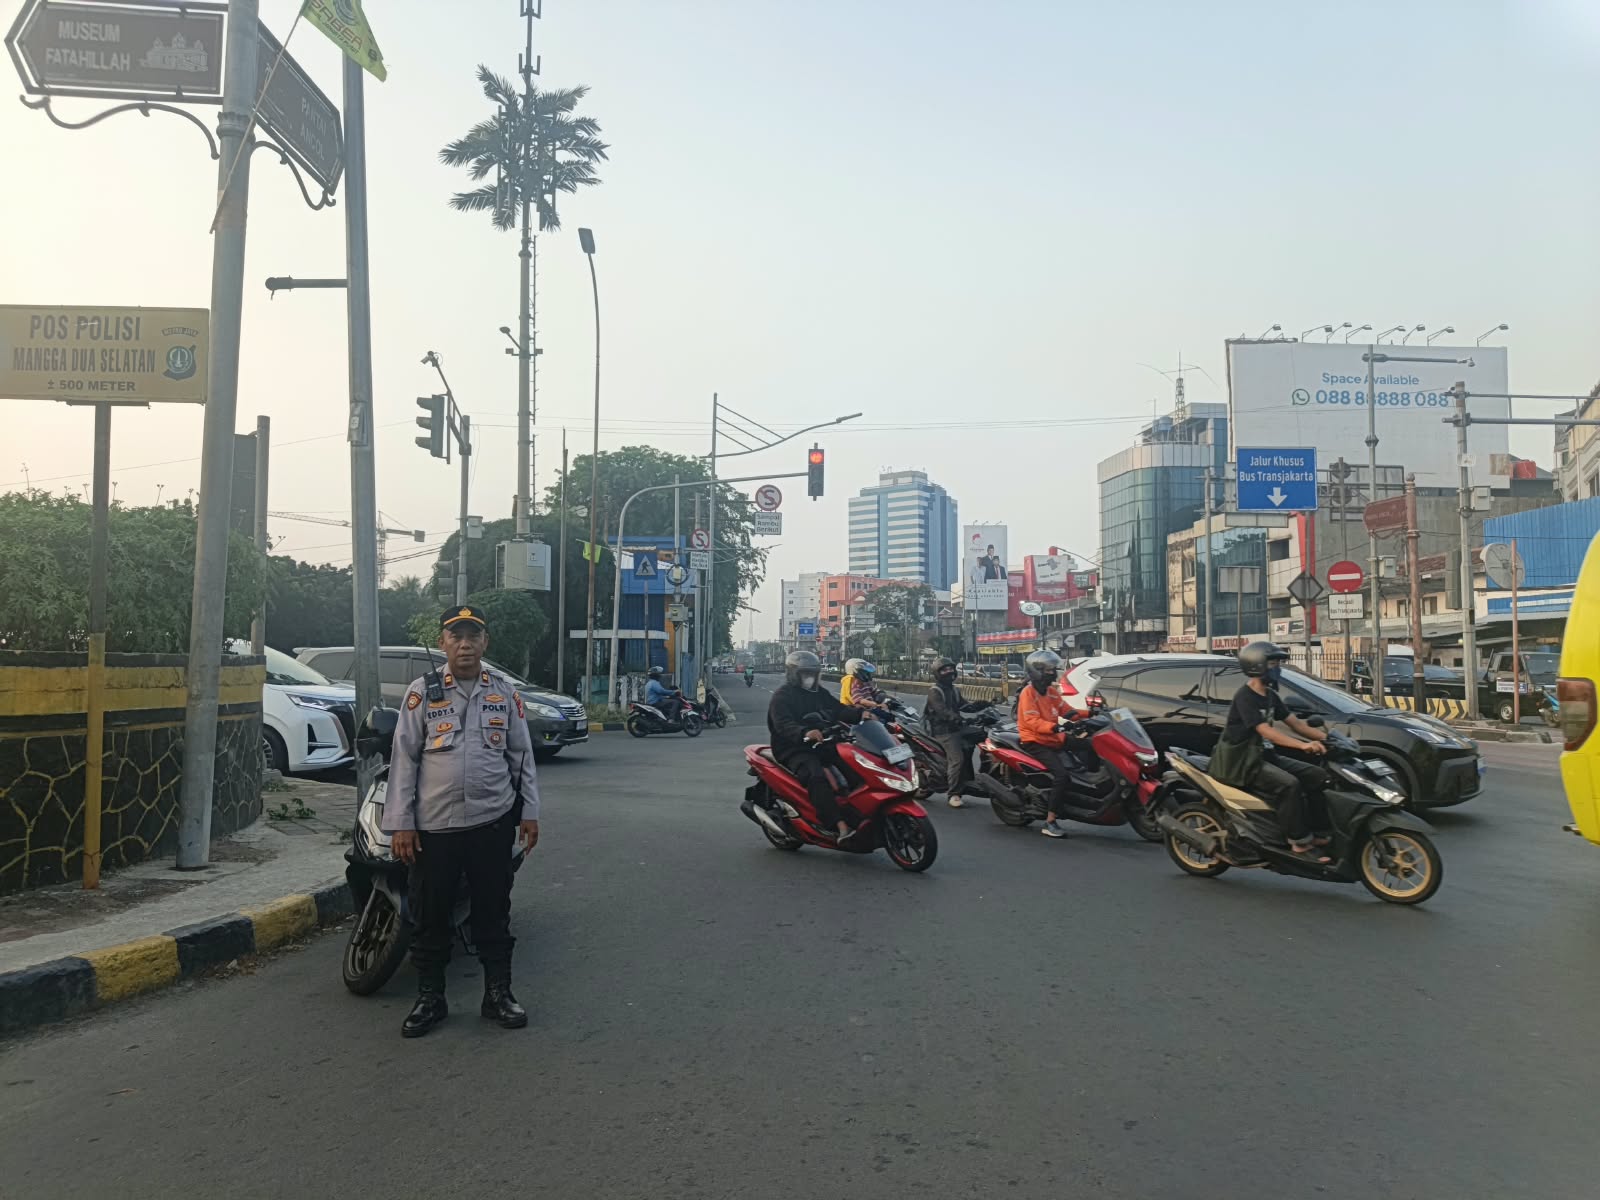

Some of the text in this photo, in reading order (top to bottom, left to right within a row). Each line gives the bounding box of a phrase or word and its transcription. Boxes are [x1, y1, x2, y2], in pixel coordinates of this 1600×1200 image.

[58, 20, 120, 42] MUSEUM
[46, 47, 131, 72] FATAHILLAH
[301, 97, 327, 138] PANTAI
[30, 314, 141, 341] POS POLISI
[12, 347, 156, 374] MANGGA DUA SELATAN
[60, 380, 84, 391] 500
[88, 380, 136, 392] METER
[1322, 372, 1362, 386] Space
[1315, 389, 1351, 405] 088
[1414, 392, 1449, 407] 088
[1250, 455, 1305, 467] Jalur Khusus
[1239, 470, 1314, 485] Bus Transjakarta
[482, 704, 507, 712] POLRI
